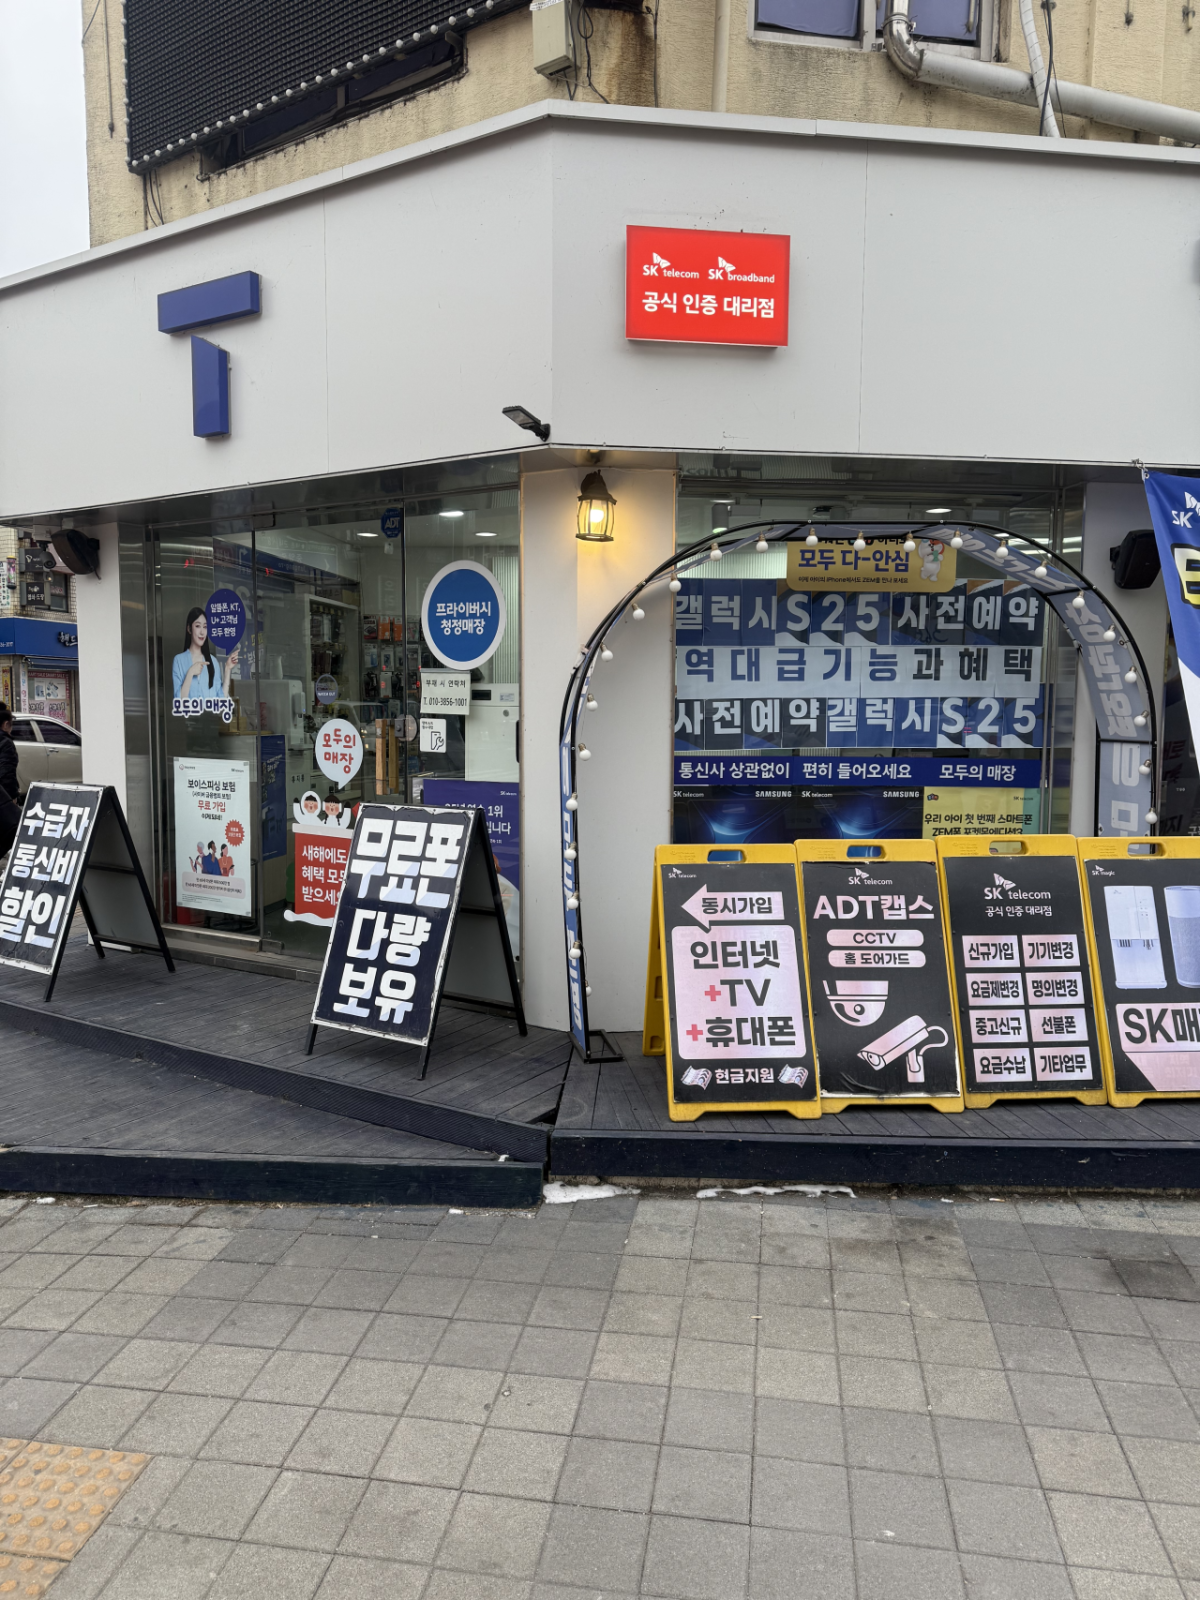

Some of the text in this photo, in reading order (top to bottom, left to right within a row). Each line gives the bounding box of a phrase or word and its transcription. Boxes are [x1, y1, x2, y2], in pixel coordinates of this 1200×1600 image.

[643, 265, 699, 279] SK telecom
[708, 269, 775, 283] SK broadband
[642, 292, 774, 318] 공식 인증 대리점
[385, 517, 400, 528] ADT
[1172, 510, 1193, 528] SK
[798, 549, 910, 572] 모두 다-안심
[230, 603, 240, 612] KT,
[436, 602, 491, 617] 프라이버시
[210, 616, 238, 624] U+ 고객님
[440, 619, 485, 636] 청정매장
[212, 627, 236, 637] 모두 환영
[448, 680, 466, 688] 연락처
[173, 698, 234, 722] 모두의 매장
[322, 728, 356, 748] 모두의
[324, 752, 353, 774] 매장
[678, 762, 1016, 781] 통신사 상관없이 편히 들어오세요 모두의 매장
[188, 779, 236, 792] 보이스피싱 보험
[198, 800, 226, 812] 무료 가입
[488, 805, 503, 818] 1위
[22, 802, 91, 841] 수급자
[924, 814, 1033, 825] 우리 아이 첫 번째 스마트폰
[302, 845, 347, 864] 새해에도
[350, 818, 464, 909] 무료폰
[11, 843, 79, 885] 통신비
[302, 866, 324, 883] 혜택
[848, 877, 861, 885] SK
[984, 888, 1051, 900] SK telecom
[702, 897, 773, 914] 동시가입
[813, 895, 935, 920] ADT캡스
[985, 906, 1052, 917] 공식 인증 대리점
[0, 886, 66, 948] 할인
[347, 908, 432, 967] 다량
[853, 933, 897, 944] CCTV
[690, 940, 780, 969] 인터넷
[844, 952, 910, 965] 홈 도어가드
[968, 942, 1014, 961] 신규가입
[1028, 942, 1074, 960] 기기변경
[333, 963, 416, 1024] 보유
[970, 980, 1020, 998] 요금제변경
[1032, 979, 1078, 998] 명의변경
[976, 1017, 1022, 1036] 중고신규
[1042, 1016, 1076, 1034] 선불폰
[1122, 1008, 1200, 1044] SK매
[980, 1056, 1026, 1075] 요금수납
[1040, 1054, 1087, 1074] 기타업무
[715, 1068, 775, 1084] 현금지원
